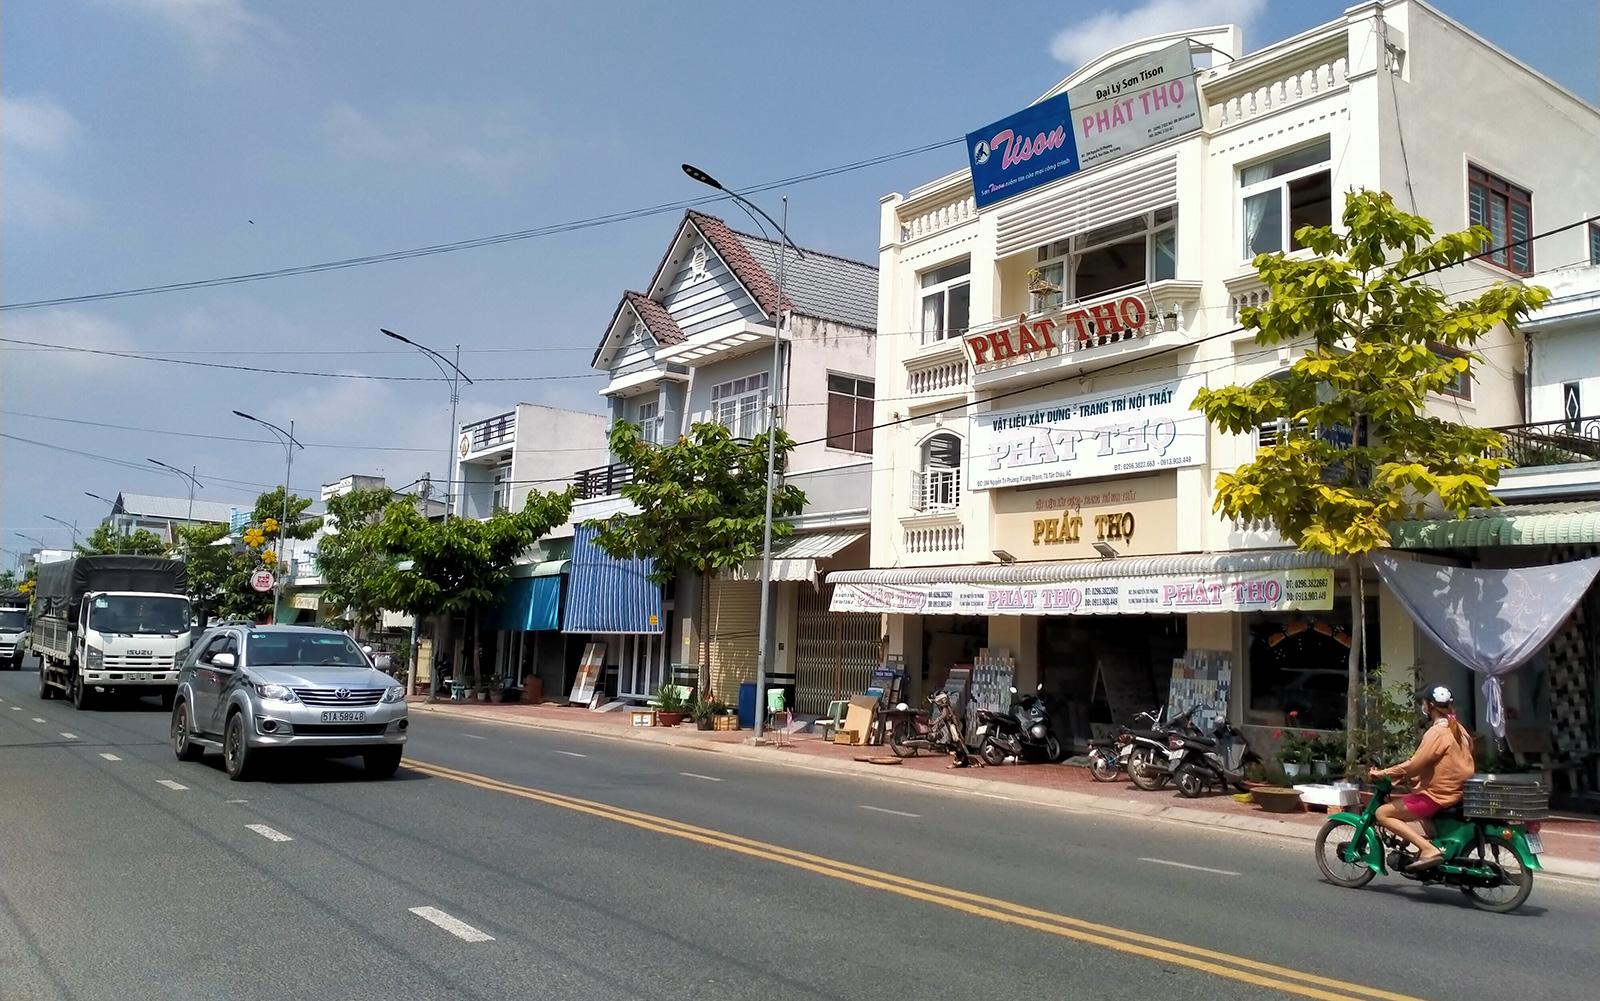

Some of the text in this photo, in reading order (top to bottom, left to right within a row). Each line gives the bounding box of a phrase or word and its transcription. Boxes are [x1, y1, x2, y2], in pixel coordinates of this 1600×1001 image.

[1096, 65, 1164, 100] Đại Lý Sơn Tison
[1081, 98, 1135, 138] PHÁT
[1138, 79, 1184, 115] THỌ
[990, 124, 1066, 170] Tison
[968, 296, 1147, 365] PHÁT THỌ
[993, 417, 1006, 433] VẬT
[1009, 414, 1026, 430] LIỆU
[1029, 411, 1045, 426] XÂY
[1047, 408, 1071, 424] DỰNG
[1079, 402, 1109, 417] TRANG
[1112, 396, 1126, 412] TRÍ
[1129, 393, 1146, 411] NỘI
[1149, 387, 1173, 406] THẤT
[988, 417, 1176, 471] PHÁT THỌ
[1033, 510, 1134, 545] PHÁT THỌ
[987, 587, 1083, 612] PHÁT THỌ
[1162, 579, 1283, 608] PHÁT THỌ
